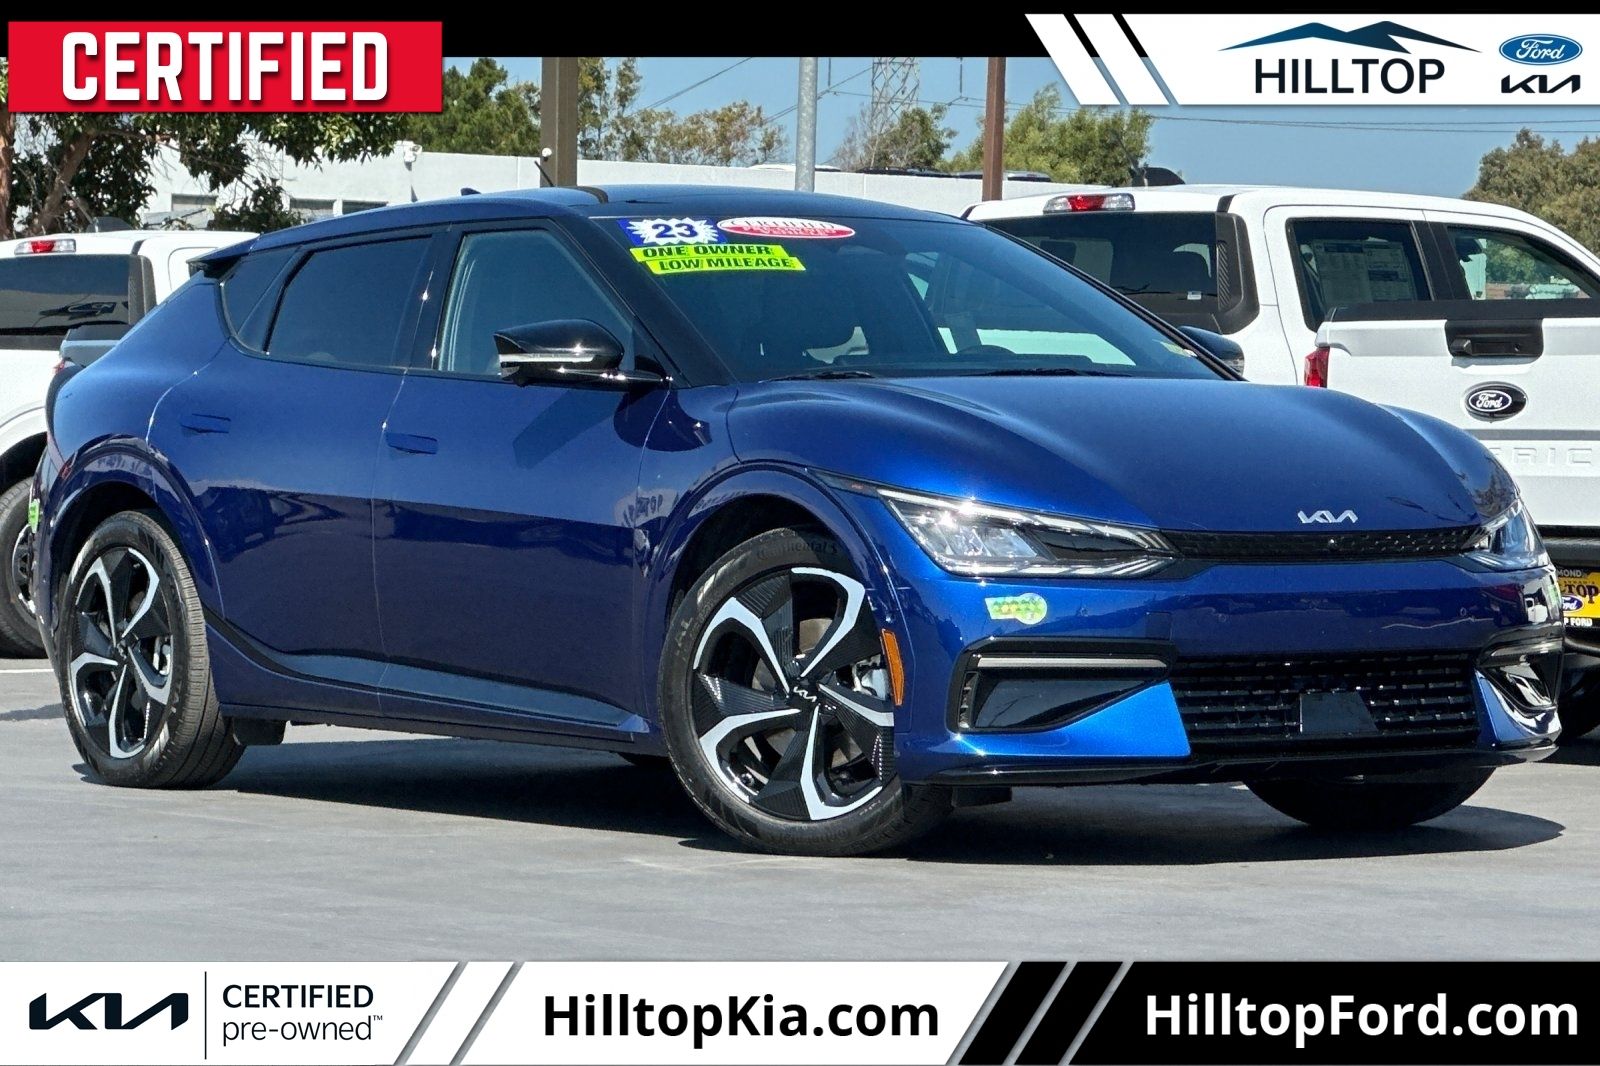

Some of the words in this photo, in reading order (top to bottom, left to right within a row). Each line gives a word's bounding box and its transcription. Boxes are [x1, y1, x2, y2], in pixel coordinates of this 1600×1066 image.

[651, 223, 698, 239] 23
[642, 247, 687, 258] ONE
[693, 245, 771, 256] OWNER
[658, 259, 703, 271] LOW
[707, 257, 793, 269] MILEAGE
